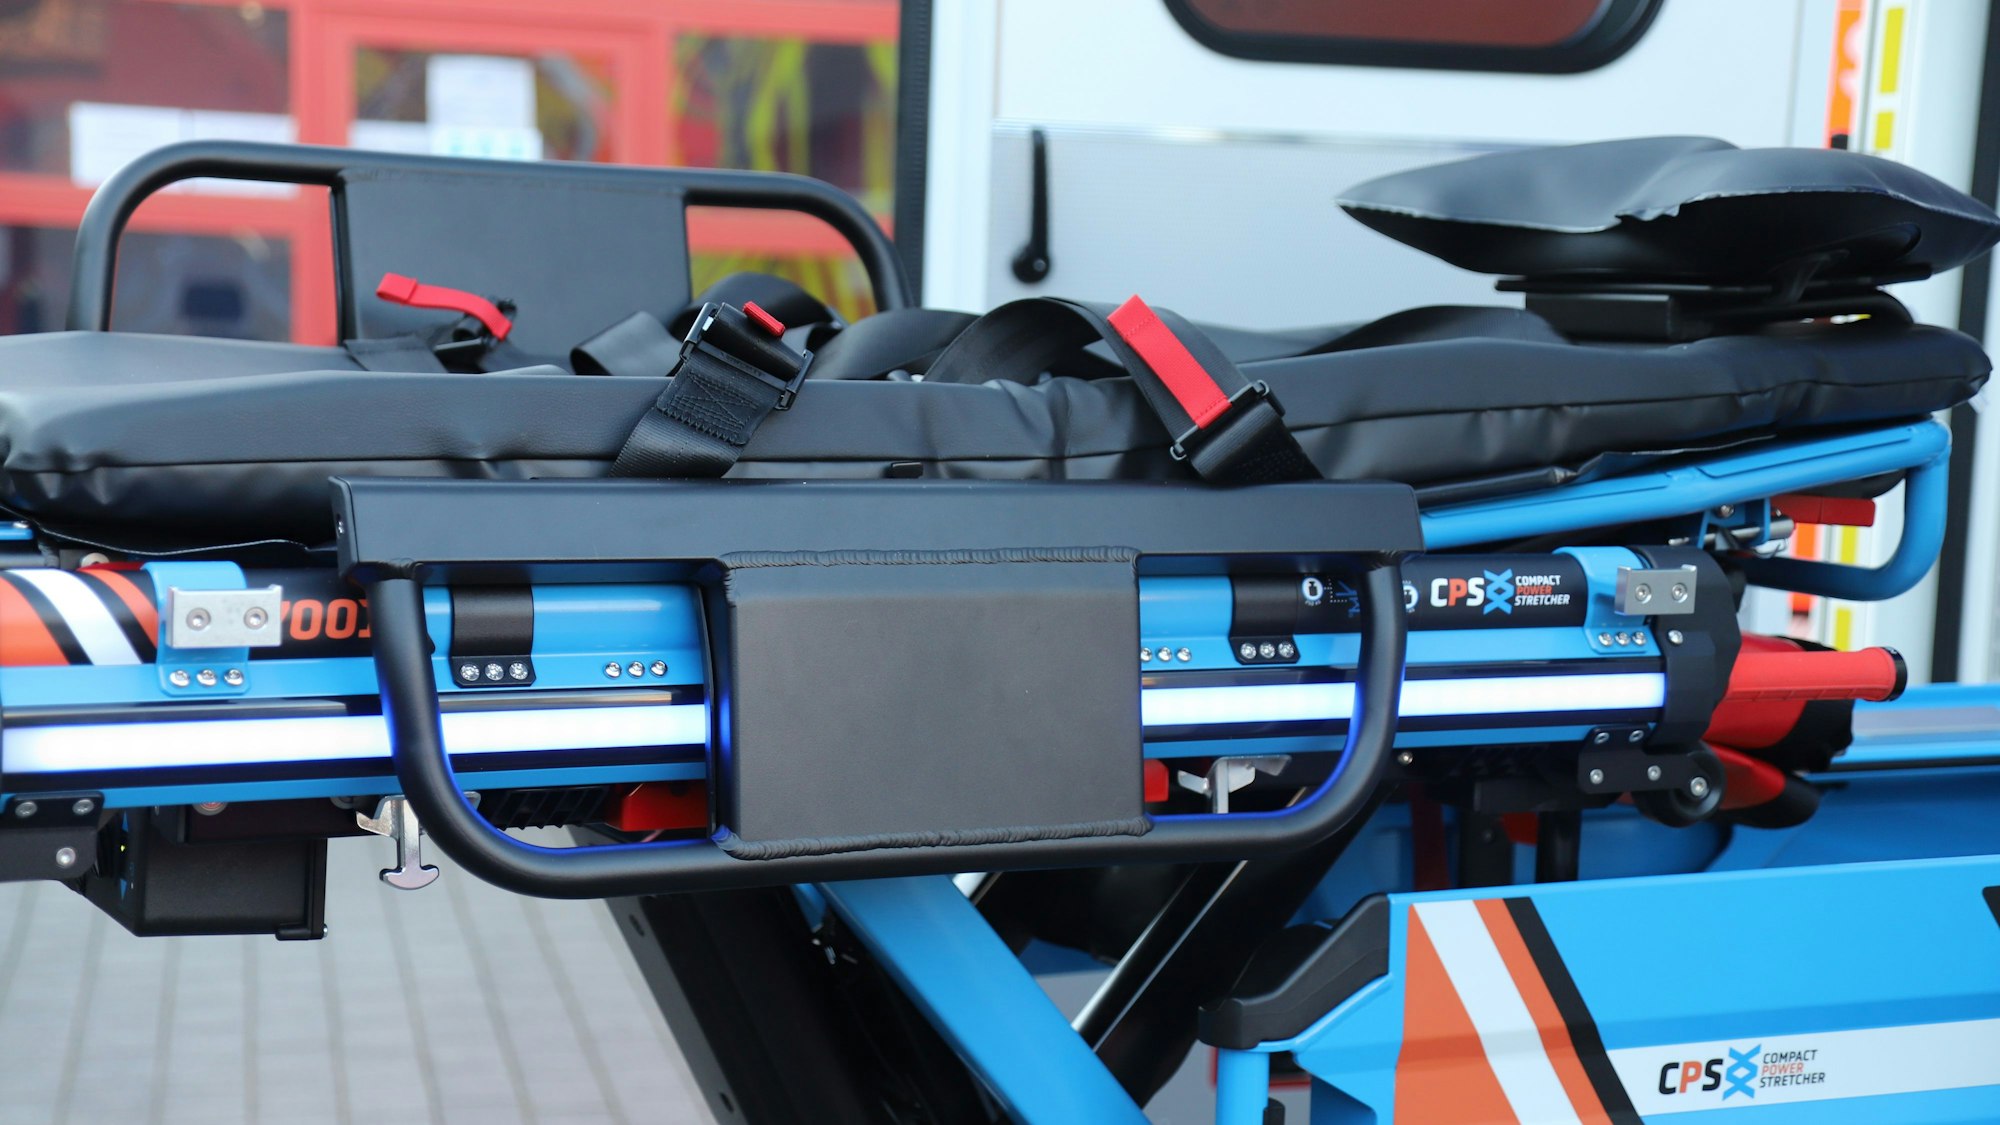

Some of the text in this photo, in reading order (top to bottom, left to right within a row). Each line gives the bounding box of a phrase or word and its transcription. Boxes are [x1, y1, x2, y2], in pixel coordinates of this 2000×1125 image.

[1515, 575, 1561, 586] COMPACT
[1516, 585, 1553, 595] POWER
[1514, 594, 1570, 606] STRETCHER
[1763, 1049, 1818, 1064] COMPACT
[1761, 1063, 1804, 1076] POWER
[1760, 1072, 1826, 1088] STRETCHER
